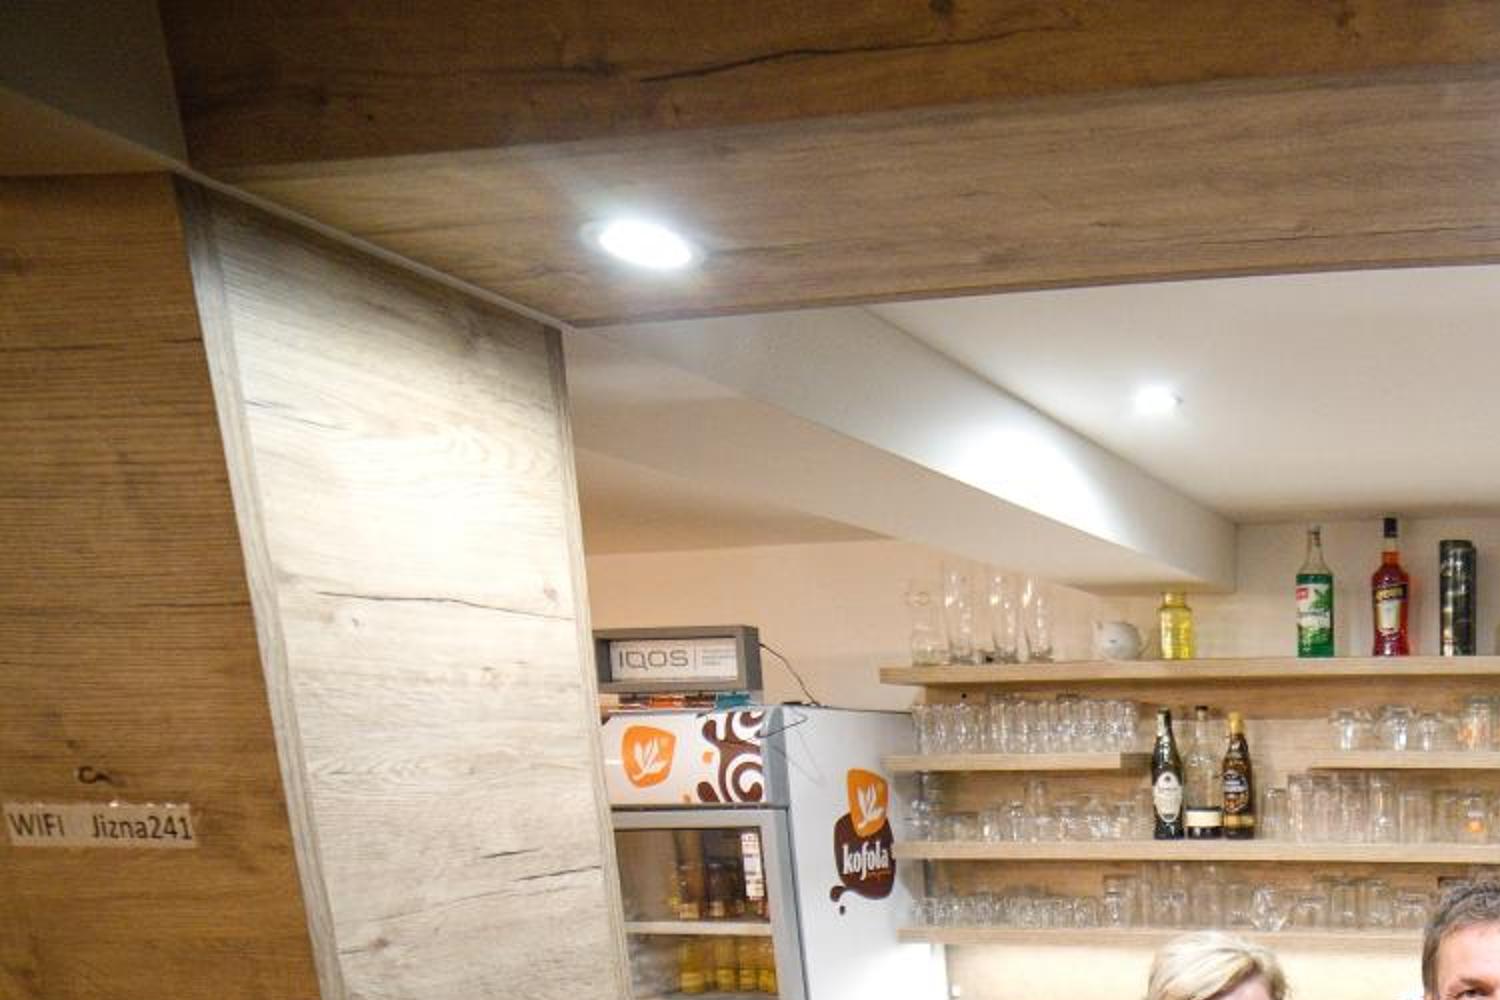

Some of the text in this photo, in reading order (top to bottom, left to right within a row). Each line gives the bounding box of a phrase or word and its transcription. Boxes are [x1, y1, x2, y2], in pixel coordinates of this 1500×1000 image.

[618, 649, 689, 671] IQOS
[91, 813, 193, 841] Jizna241
[841, 840, 890, 881] kofola
